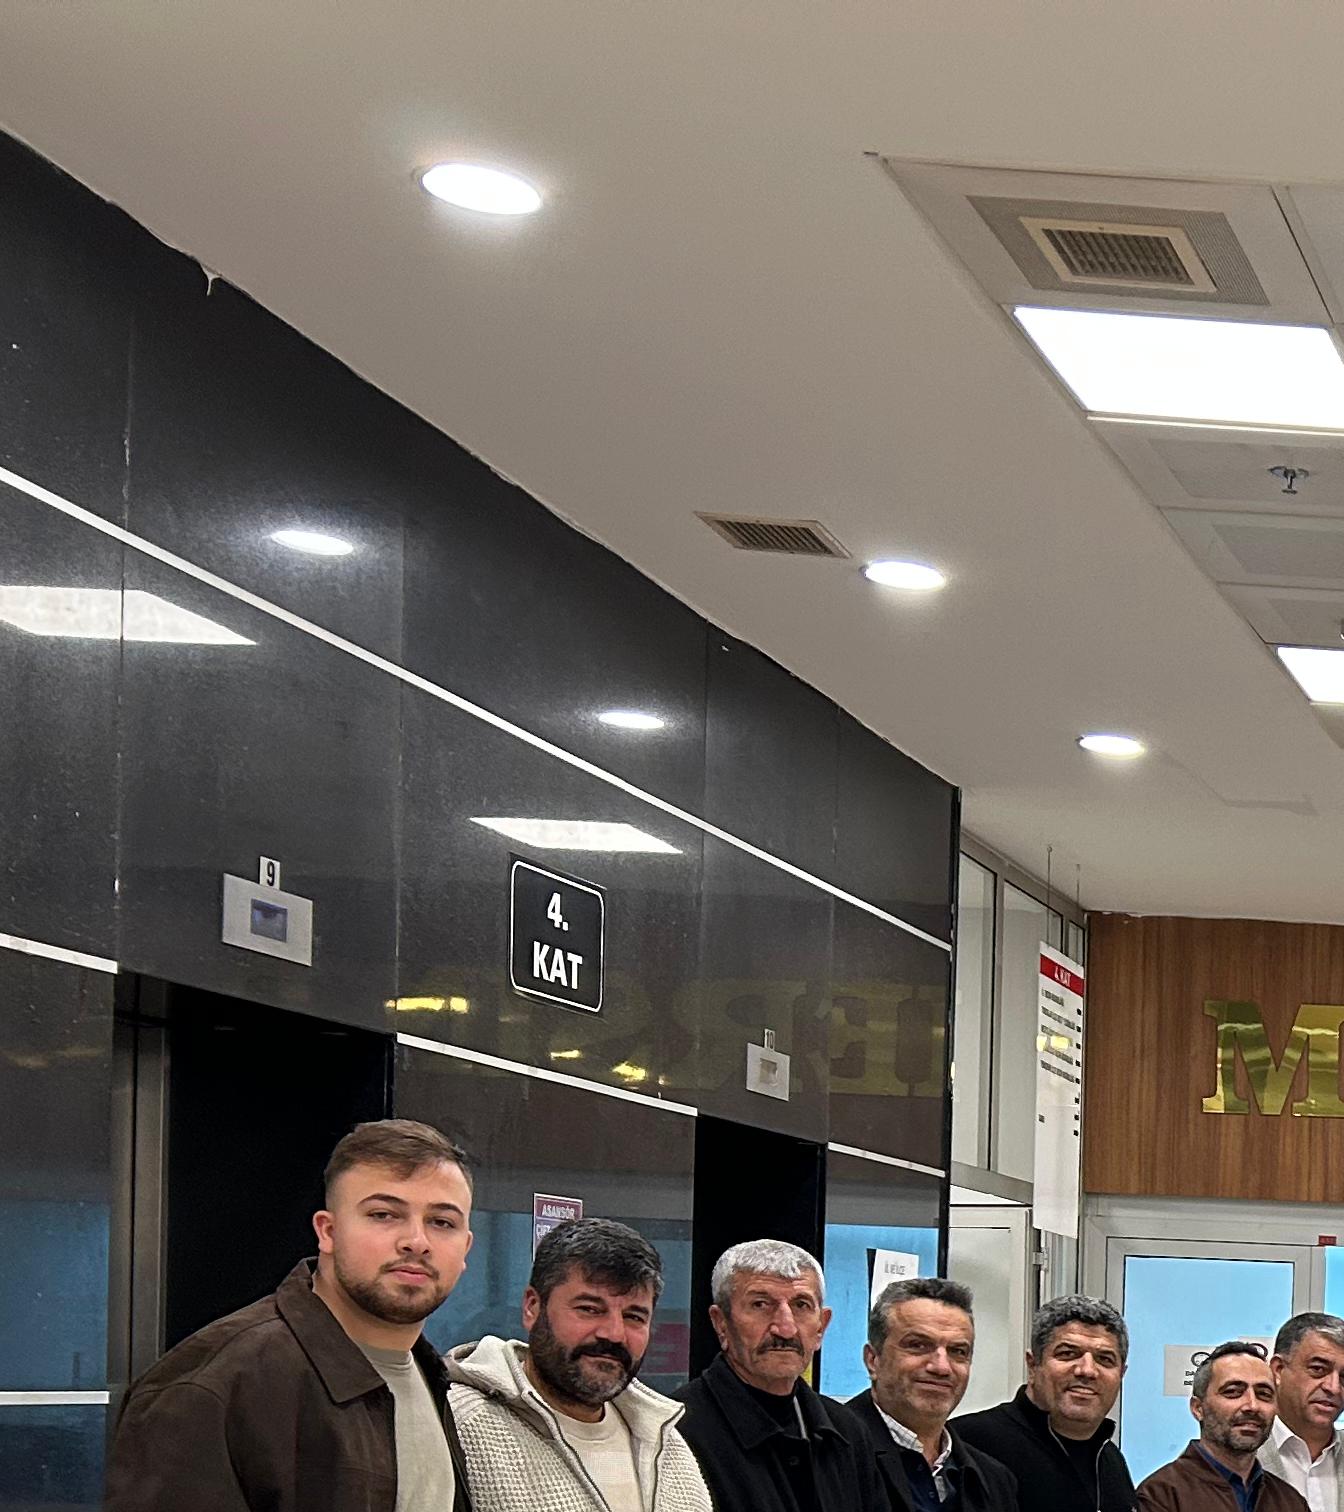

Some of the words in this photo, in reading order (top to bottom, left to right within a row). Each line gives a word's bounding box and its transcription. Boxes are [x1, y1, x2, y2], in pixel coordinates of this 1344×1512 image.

[267, 861, 276, 888] 9
[547, 892, 569, 931] 4.
[533, 940, 583, 989] KAT
[541, 1204, 575, 1220] ASANSÖR
